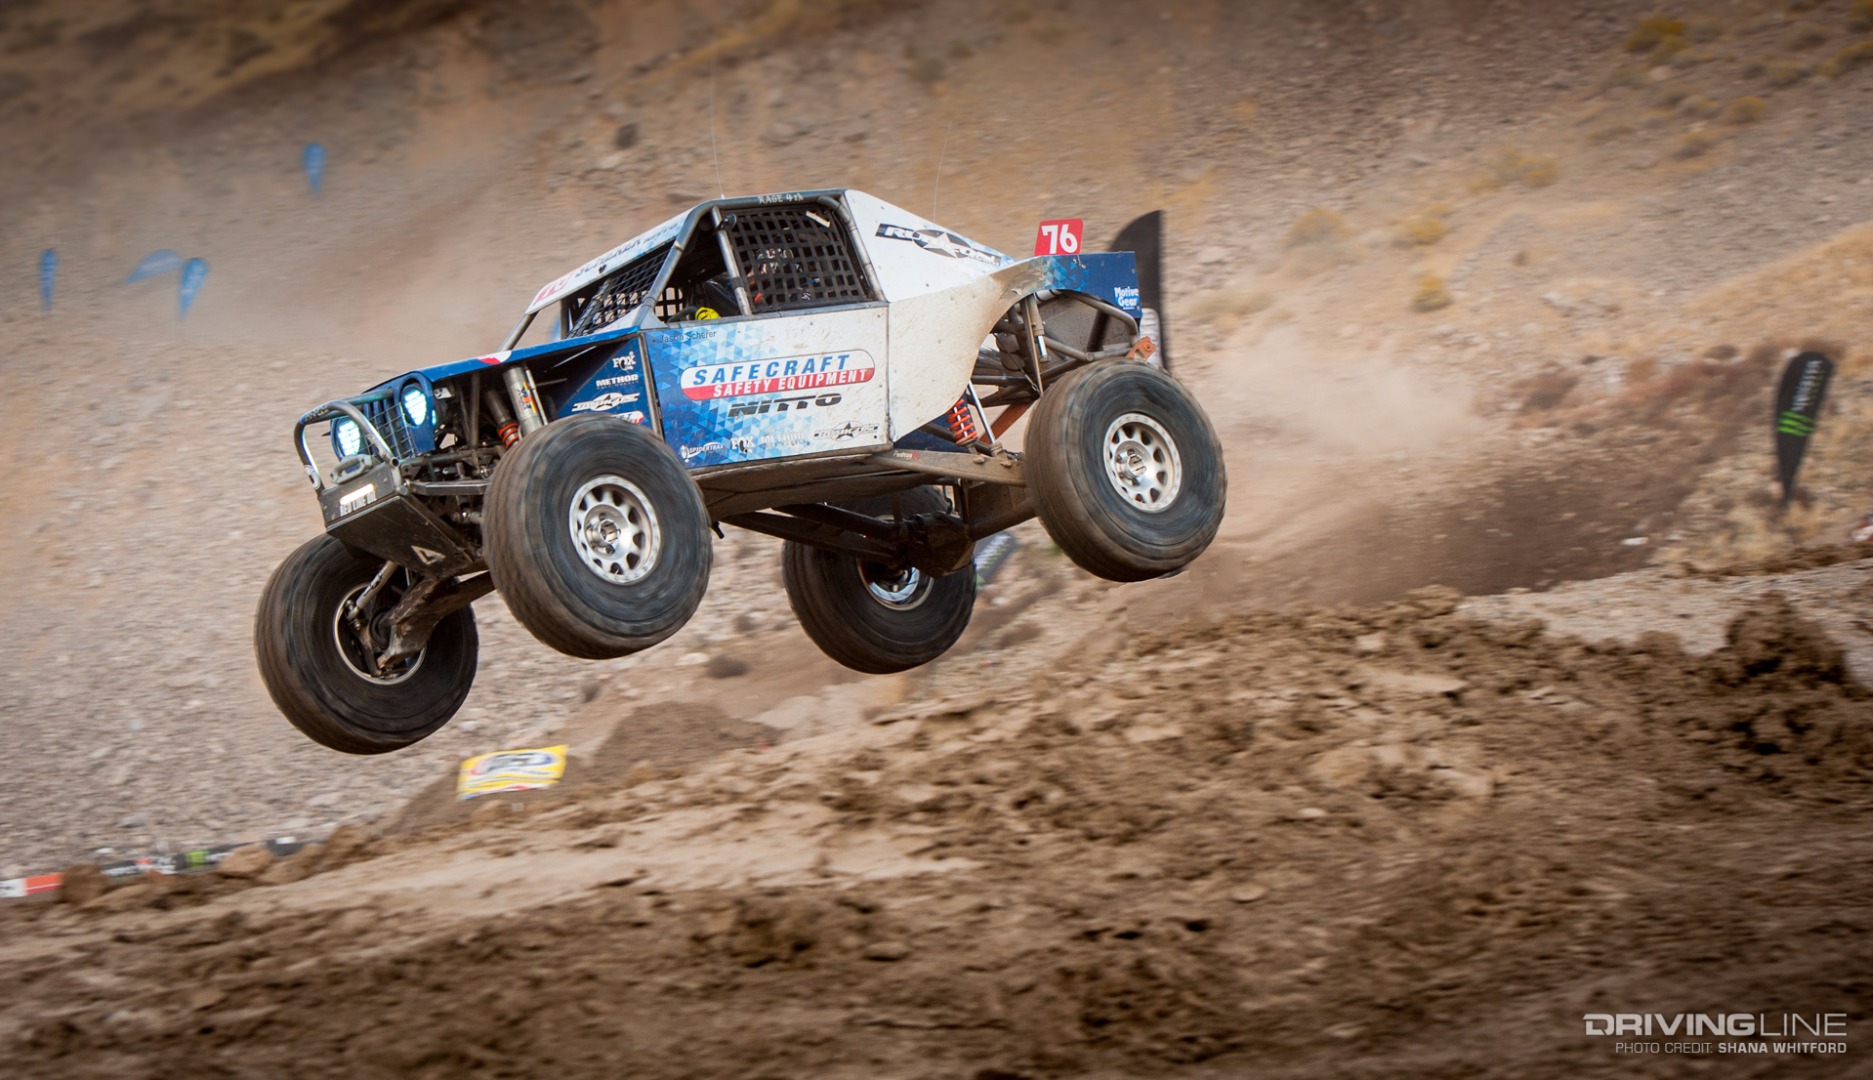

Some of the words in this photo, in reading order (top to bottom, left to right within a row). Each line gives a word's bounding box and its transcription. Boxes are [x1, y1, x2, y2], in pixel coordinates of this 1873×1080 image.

[1041, 224, 1078, 254] 76
[1114, 286, 1139, 297] Motive
[1118, 296, 1137, 307] Gear
[661, 334, 684, 343] Jason
[686, 331, 717, 340] Scherer
[612, 354, 636, 370] FOX
[692, 354, 850, 386] SAFECRAFT
[596, 374, 639, 387] METHOD
[713, 379, 771, 398] SAFETY
[777, 369, 867, 390] EQUIPMENT
[728, 393, 842, 417] NITTO
[730, 436, 756, 453] FOX
